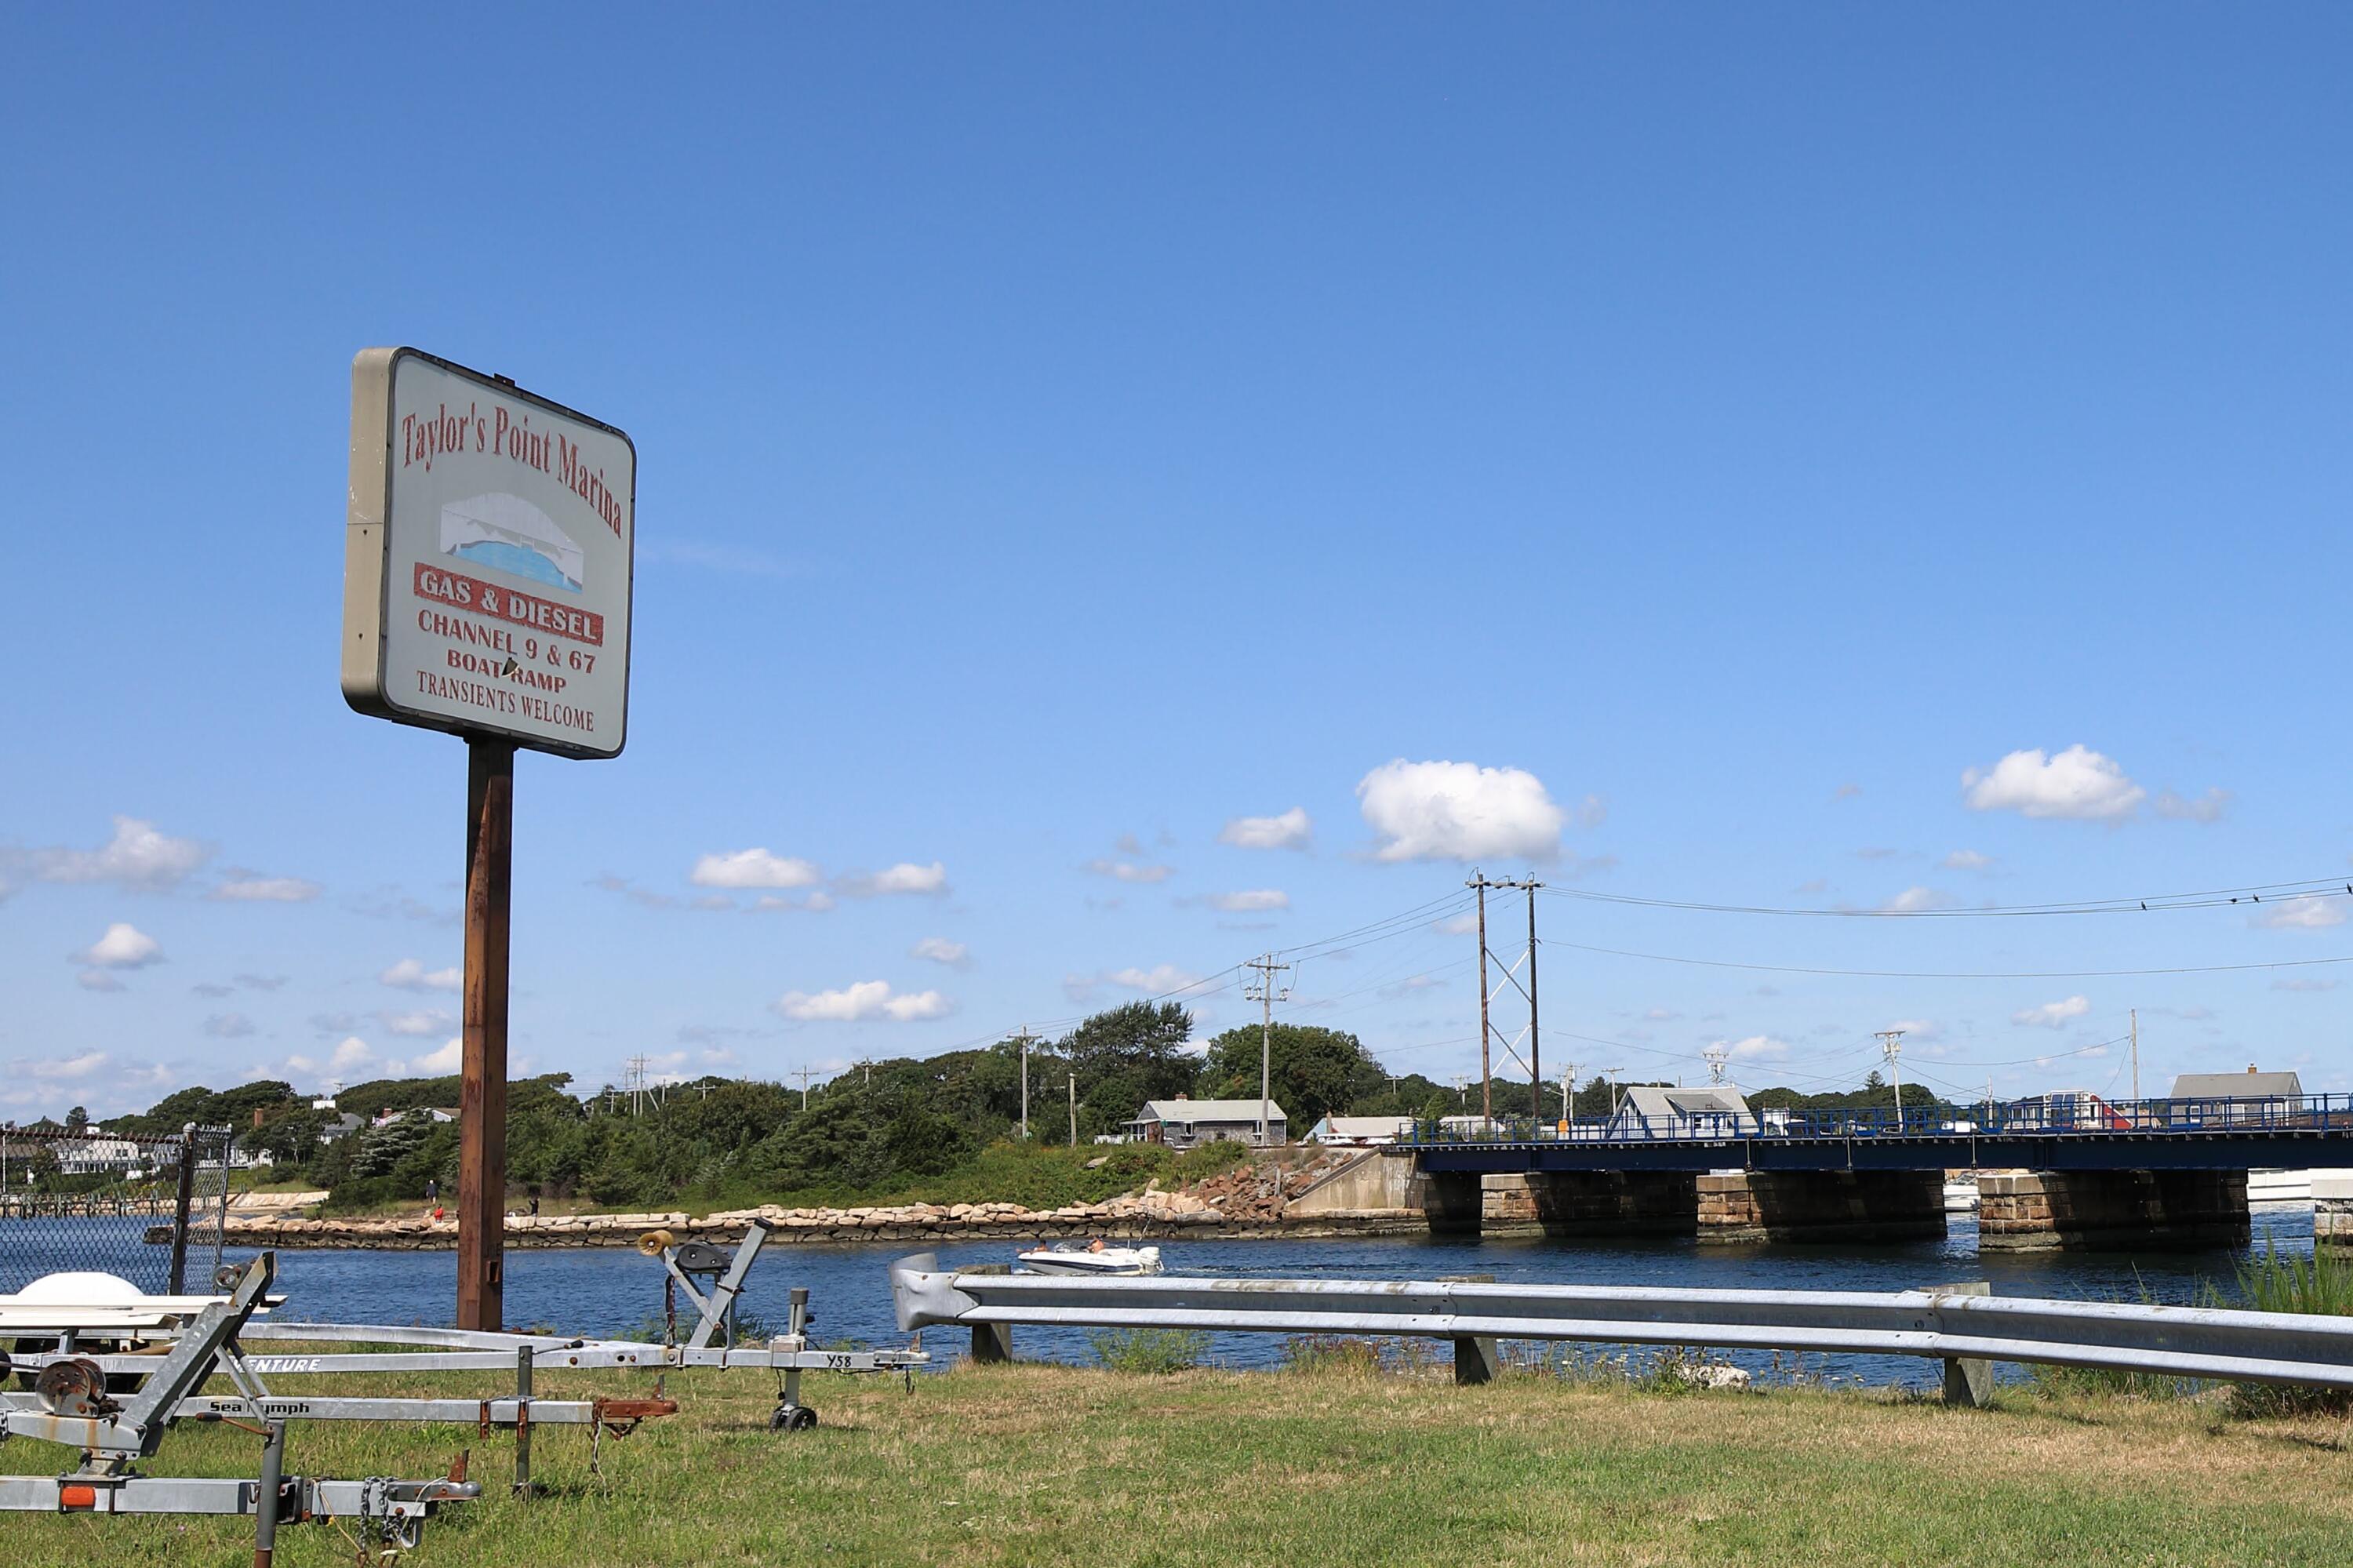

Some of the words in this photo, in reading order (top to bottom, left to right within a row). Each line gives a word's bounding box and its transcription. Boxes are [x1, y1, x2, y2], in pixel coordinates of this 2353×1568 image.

[402, 401, 486, 472] Taylor's
[493, 405, 551, 474] Point
[558, 433, 621, 540] Marina
[420, 571, 471, 604] GAS
[481, 588, 500, 613] &
[510, 595, 597, 640] DIESEL
[418, 609, 518, 656] CHANNEL
[526, 638, 538, 660] 9
[547, 645, 562, 667] &
[569, 650, 596, 675] 67
[447, 648, 503, 679] BOAT
[509, 664, 567, 693] RAMP
[416, 670, 515, 715] TRANSIENTS
[521, 695, 595, 732] WELCOME
[827, 1354, 852, 1368] Y58
[209, 1401, 242, 1412] Sea
[247, 1402, 310, 1415] ymph
